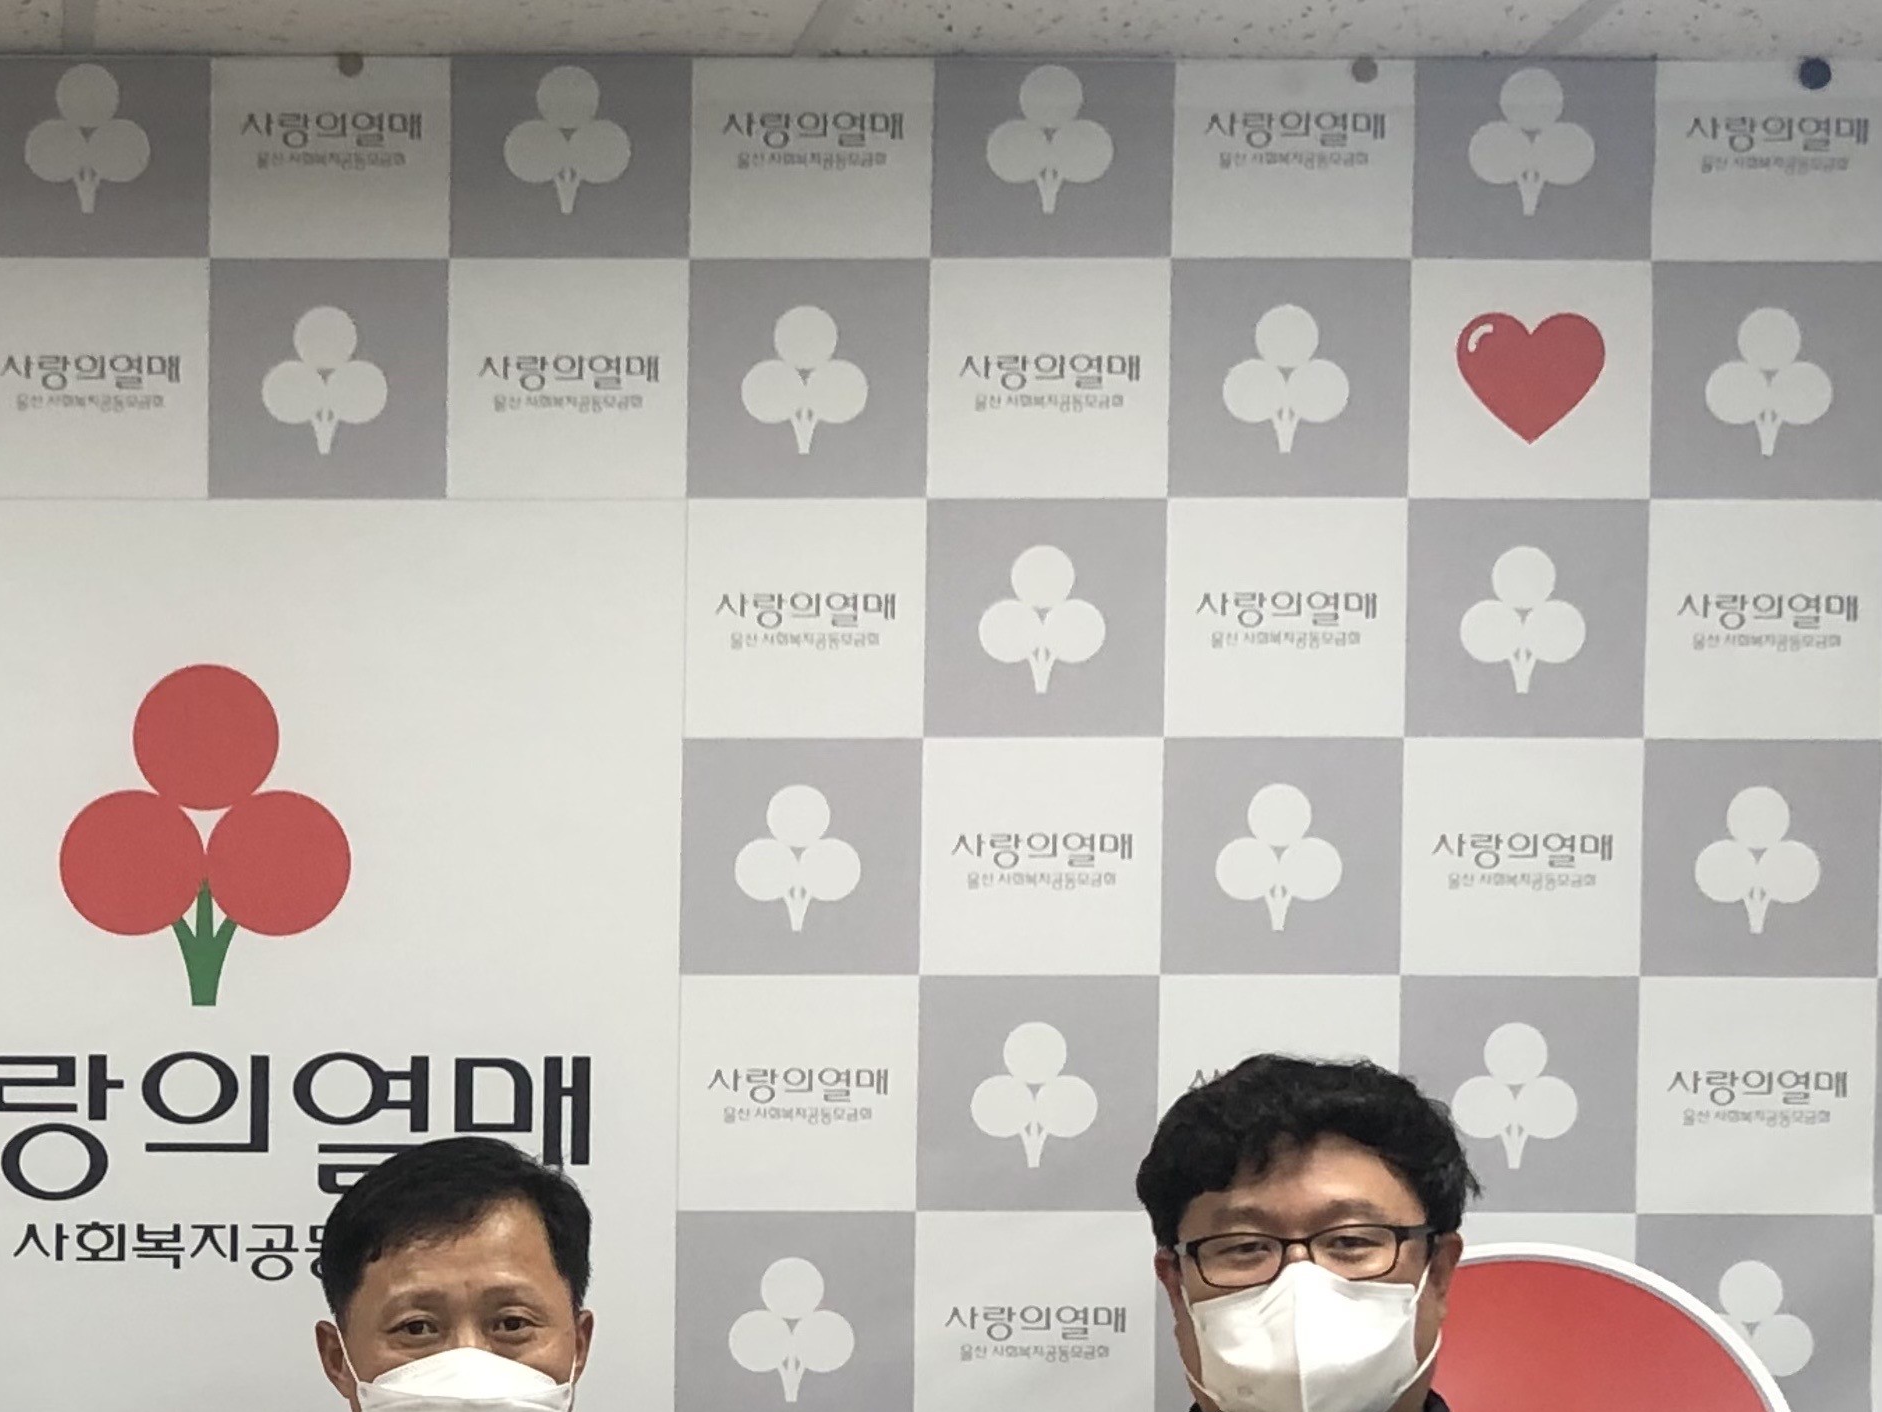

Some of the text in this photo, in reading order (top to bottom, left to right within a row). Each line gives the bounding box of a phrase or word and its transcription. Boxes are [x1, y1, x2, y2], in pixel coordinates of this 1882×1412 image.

[241, 113, 421, 147] 사랑의열매
[723, 112, 903, 148] 사랑의열매
[1205, 112, 1385, 148] 사랑의열매
[1688, 117, 1868, 152] 사랑의열매
[1, 355, 180, 391] 사랑의열매
[479, 355, 659, 391] 사랑의열매
[960, 354, 1140, 390] 사랑의열매
[716, 592, 896, 629] 사랑의열매
[1197, 591, 1377, 628] 사랑의열매
[1678, 594, 1858, 630] 사랑의열매
[952, 833, 1132, 869] 사랑의열매
[1433, 833, 1613, 869] 사랑의열매
[708, 1068, 888, 1104] 사랑의열매
[1668, 1070, 1847, 1106] 사랑의열매
[13, 1221, 325, 1281] 사회복지공
[945, 1306, 1126, 1341] 사랑의열매
